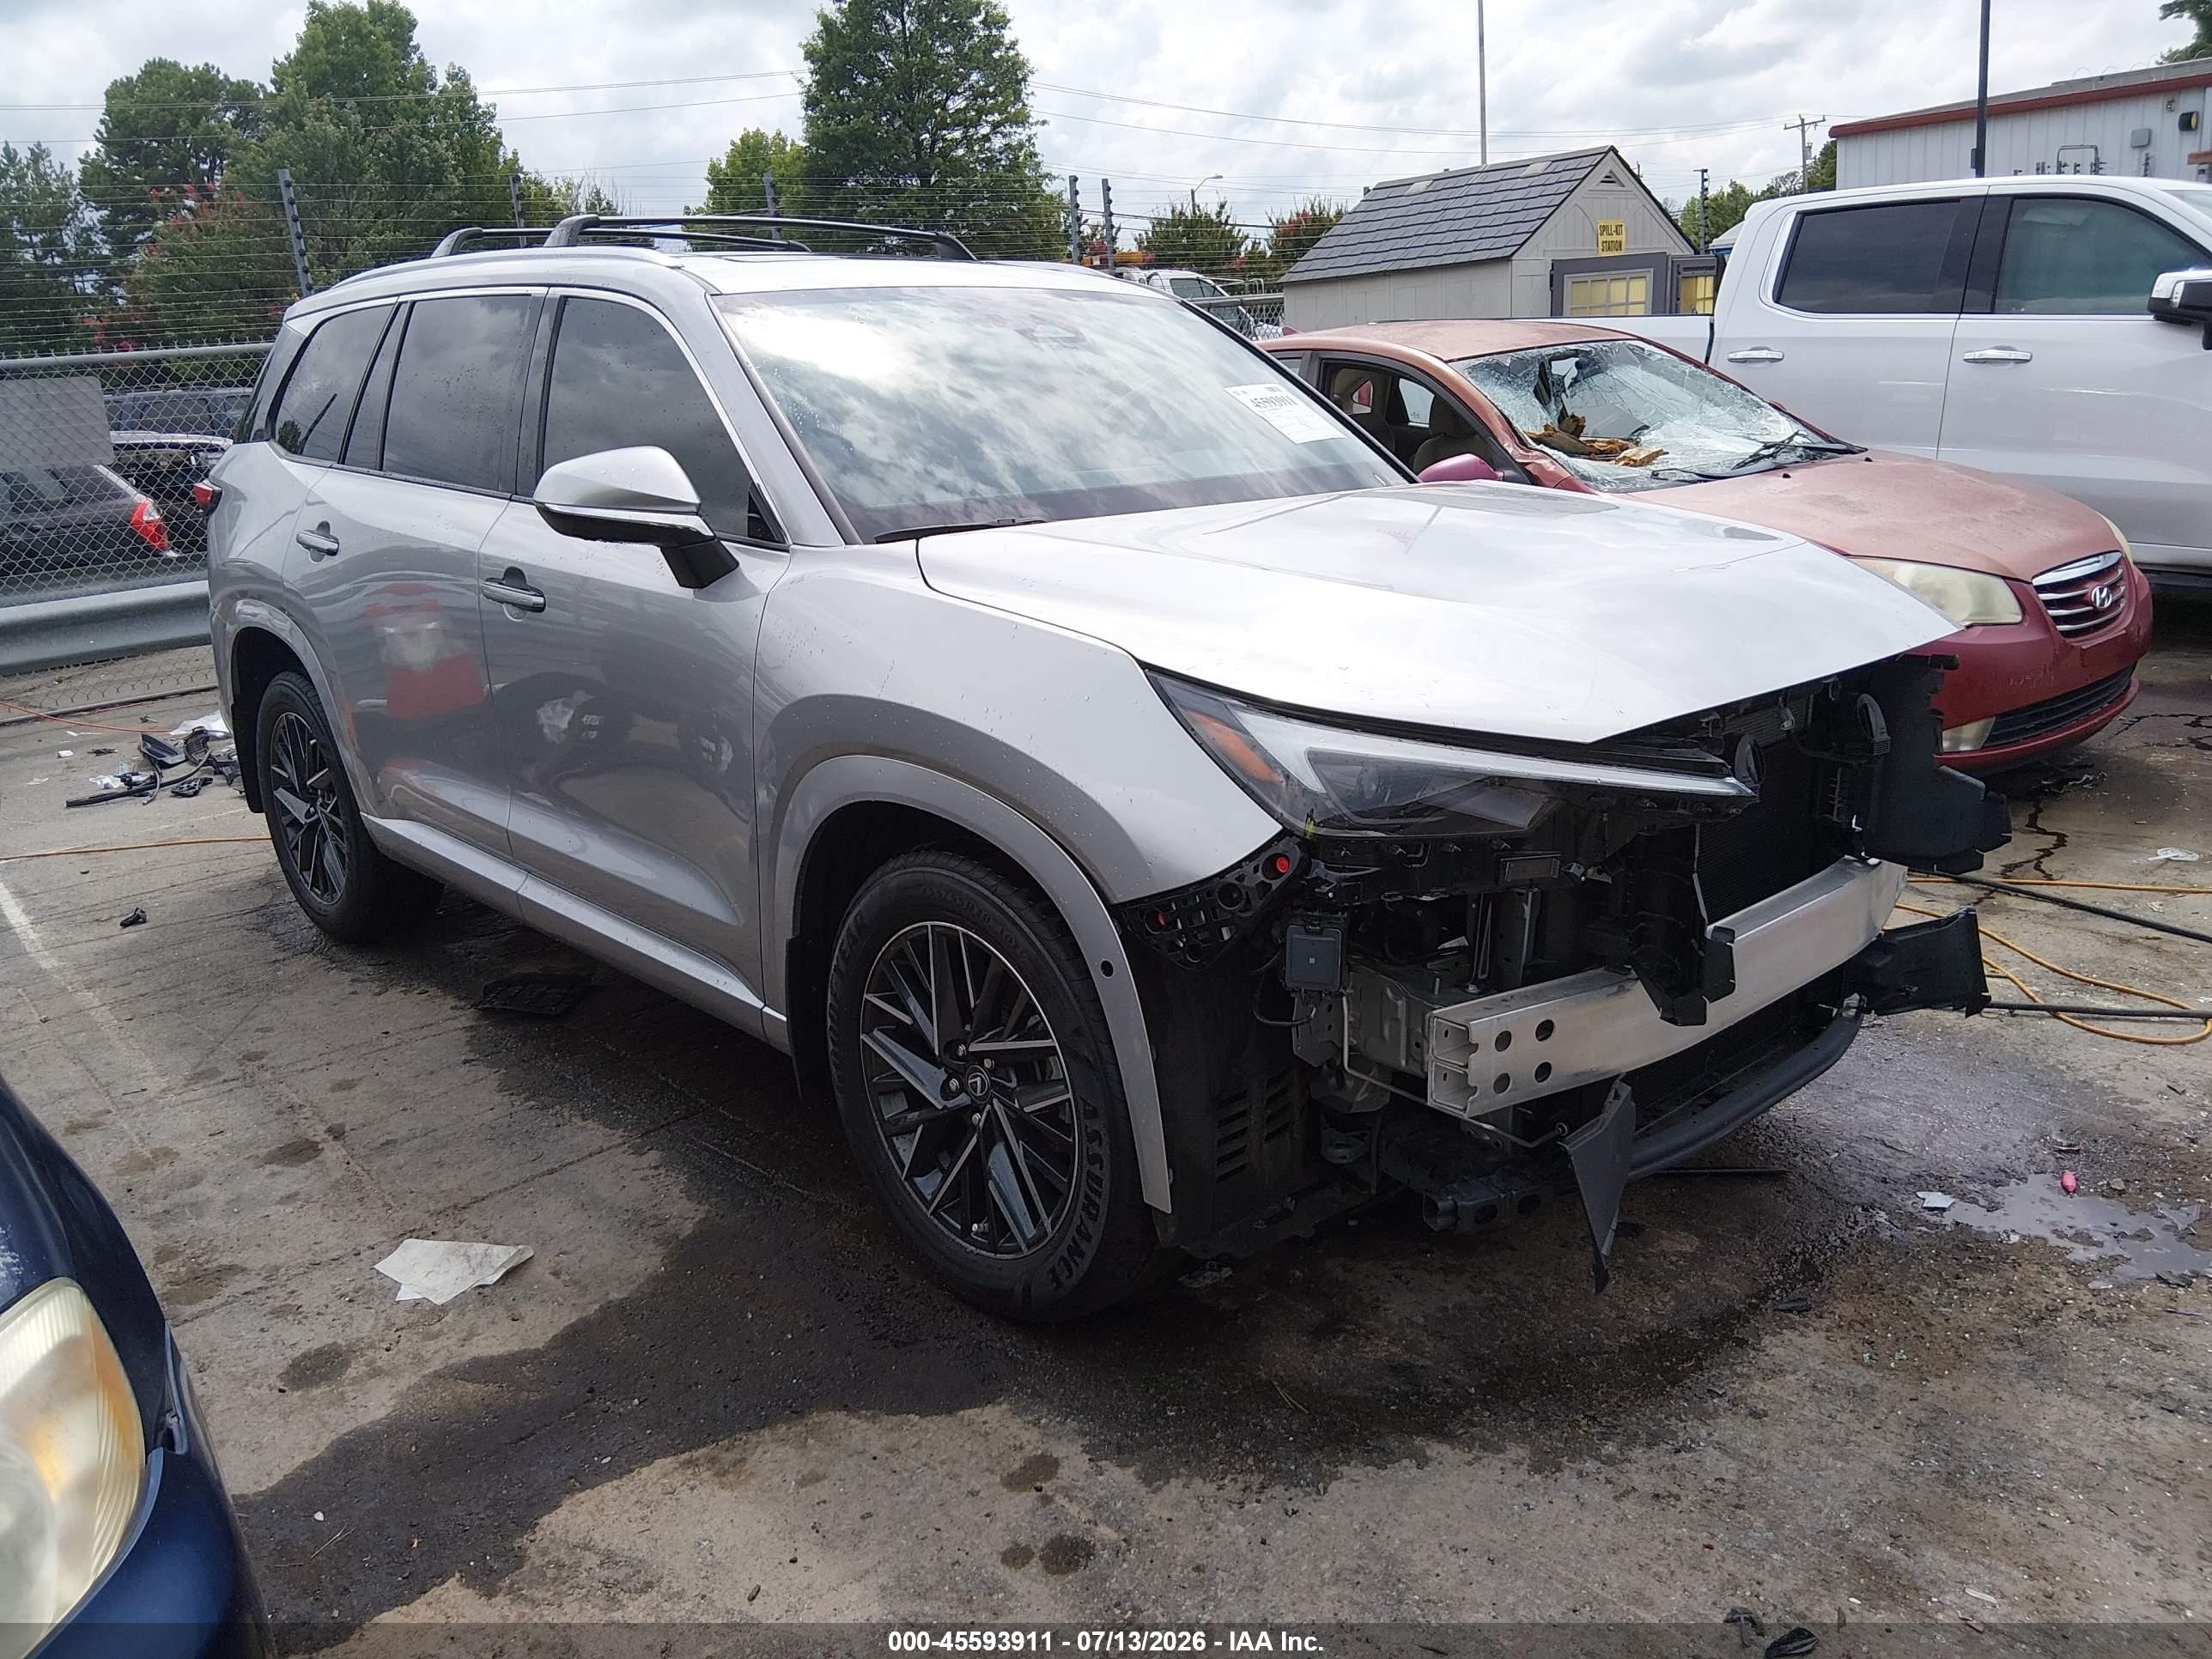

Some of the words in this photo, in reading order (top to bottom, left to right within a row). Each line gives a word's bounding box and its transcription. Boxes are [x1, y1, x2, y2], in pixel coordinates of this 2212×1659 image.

[1599, 224, 1623, 236] SPILL-KIT
[1601, 240, 1622, 252] STATION
[1045, 1098, 1105, 1291] ASSURANCE
